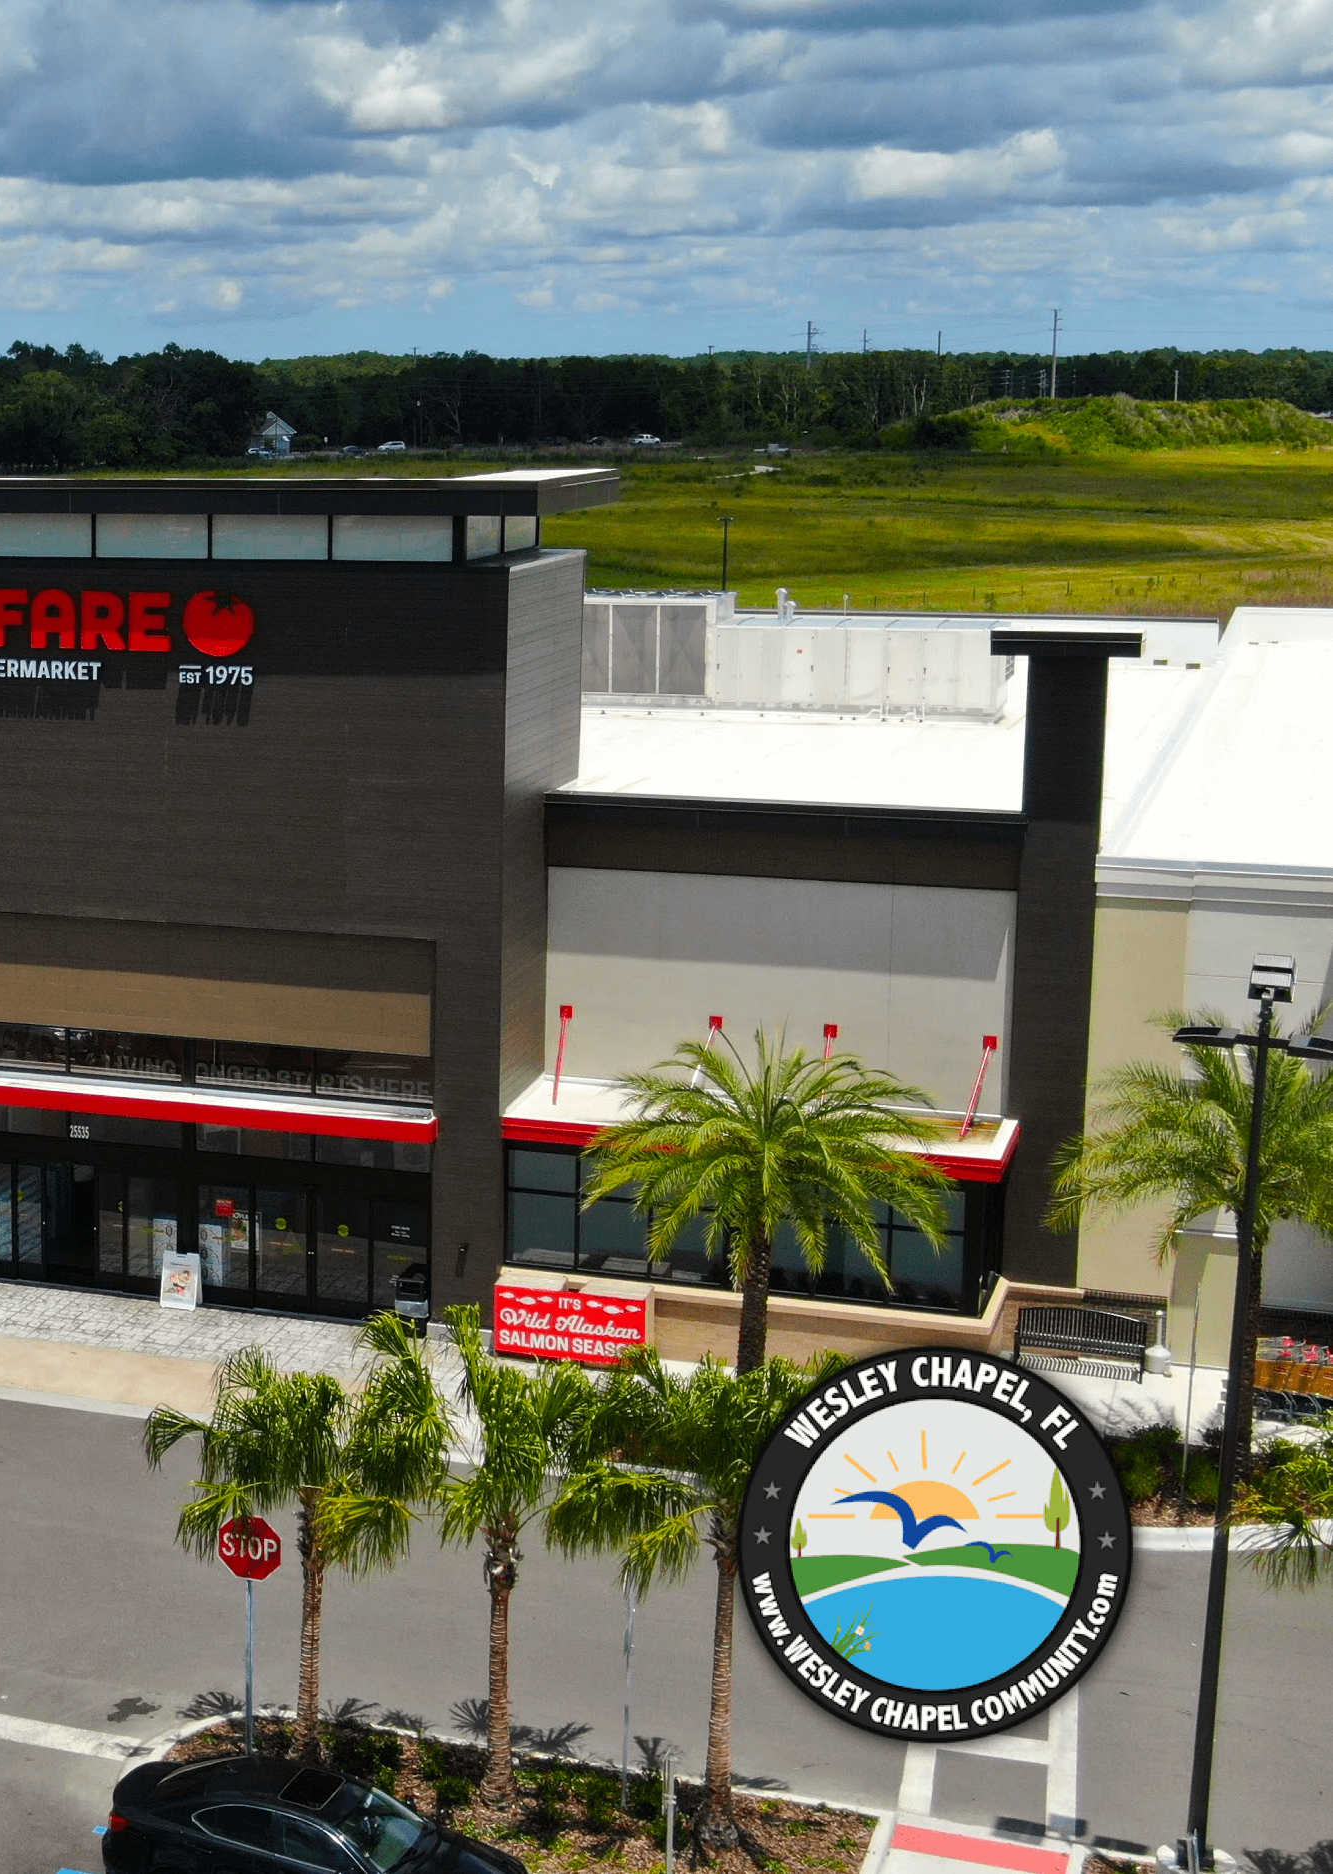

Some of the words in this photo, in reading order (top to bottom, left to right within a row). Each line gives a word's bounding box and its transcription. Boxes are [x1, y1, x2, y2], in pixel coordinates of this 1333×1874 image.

[179, 671, 202, 684] EST
[205, 665, 253, 686] 1975
[196, 1061, 276, 1083] ONGER
[558, 1297, 582, 1311] IT'S
[499, 1307, 551, 1330] Wild
[555, 1314, 642, 1341] Alaskan
[499, 1329, 569, 1352] SALMON
[572, 1338, 628, 1359] SEAS
[221, 1532, 278, 1562] STOP
